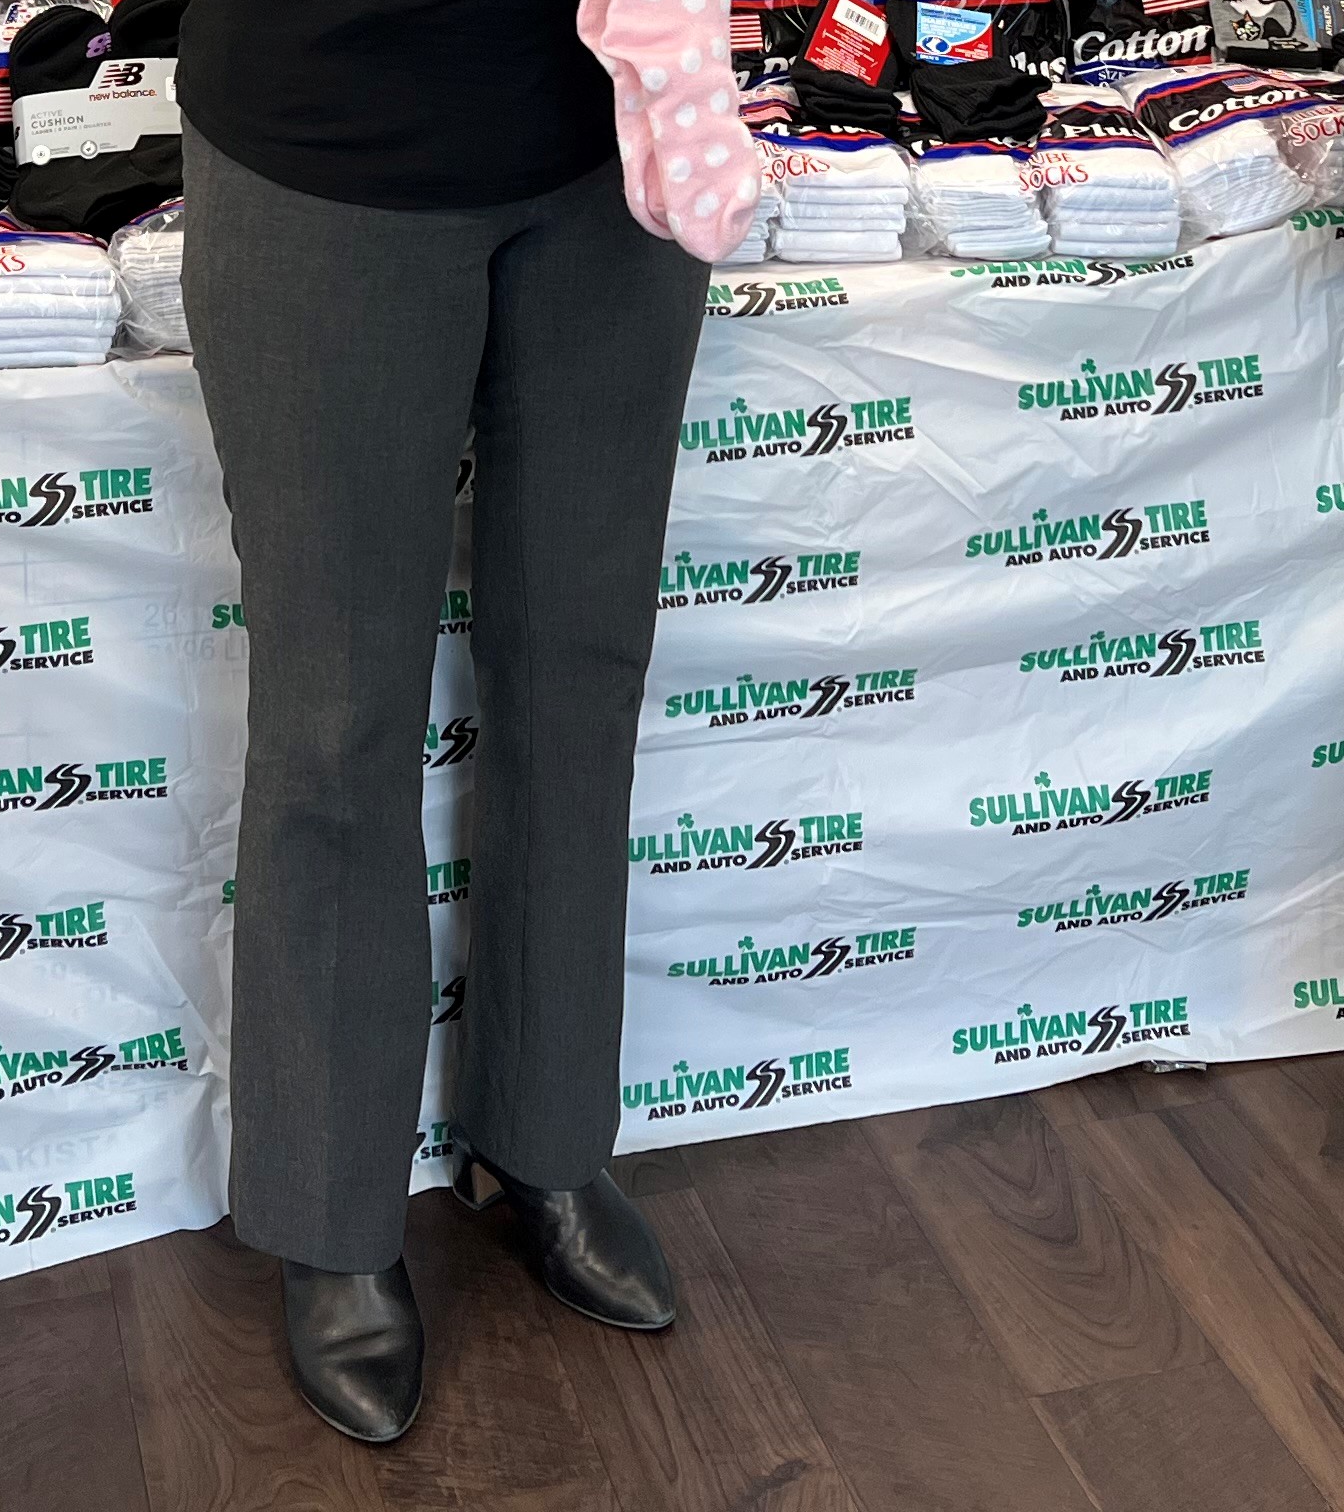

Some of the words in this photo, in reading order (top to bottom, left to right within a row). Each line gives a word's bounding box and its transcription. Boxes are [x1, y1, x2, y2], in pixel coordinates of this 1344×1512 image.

[1322, 4, 1333, 36] ATHLETIC
[1073, 24, 1213, 66] Cotton
[89, 93, 110, 102] new
[1169, 88, 1309, 134] Cotton
[31, 109, 63, 120] ACTIVE
[31, 115, 84, 129] CUSHION
[1019, 164, 1089, 191] SOCKS
[1018, 368, 1155, 410] SULLIVAN
[1197, 354, 1262, 388] TIRE
[1059, 405, 1099, 421] AND
[1104, 400, 1151, 417] AUTO
[1194, 385, 1264, 405] SERVICE
[80, 467, 153, 501] TIRE
[72, 499, 154, 519] SERVICE
[952, 1006, 1086, 1055] SULLIVAN
[1129, 996, 1188, 1028] TIRE
[994, 1045, 1033, 1064] AND
[1036, 1039, 1082, 1058] AUTO
[1121, 1023, 1190, 1045] SERVICE
[64, 1172, 136, 1205] TIRE
[57, 1201, 137, 1228] SERVICE
